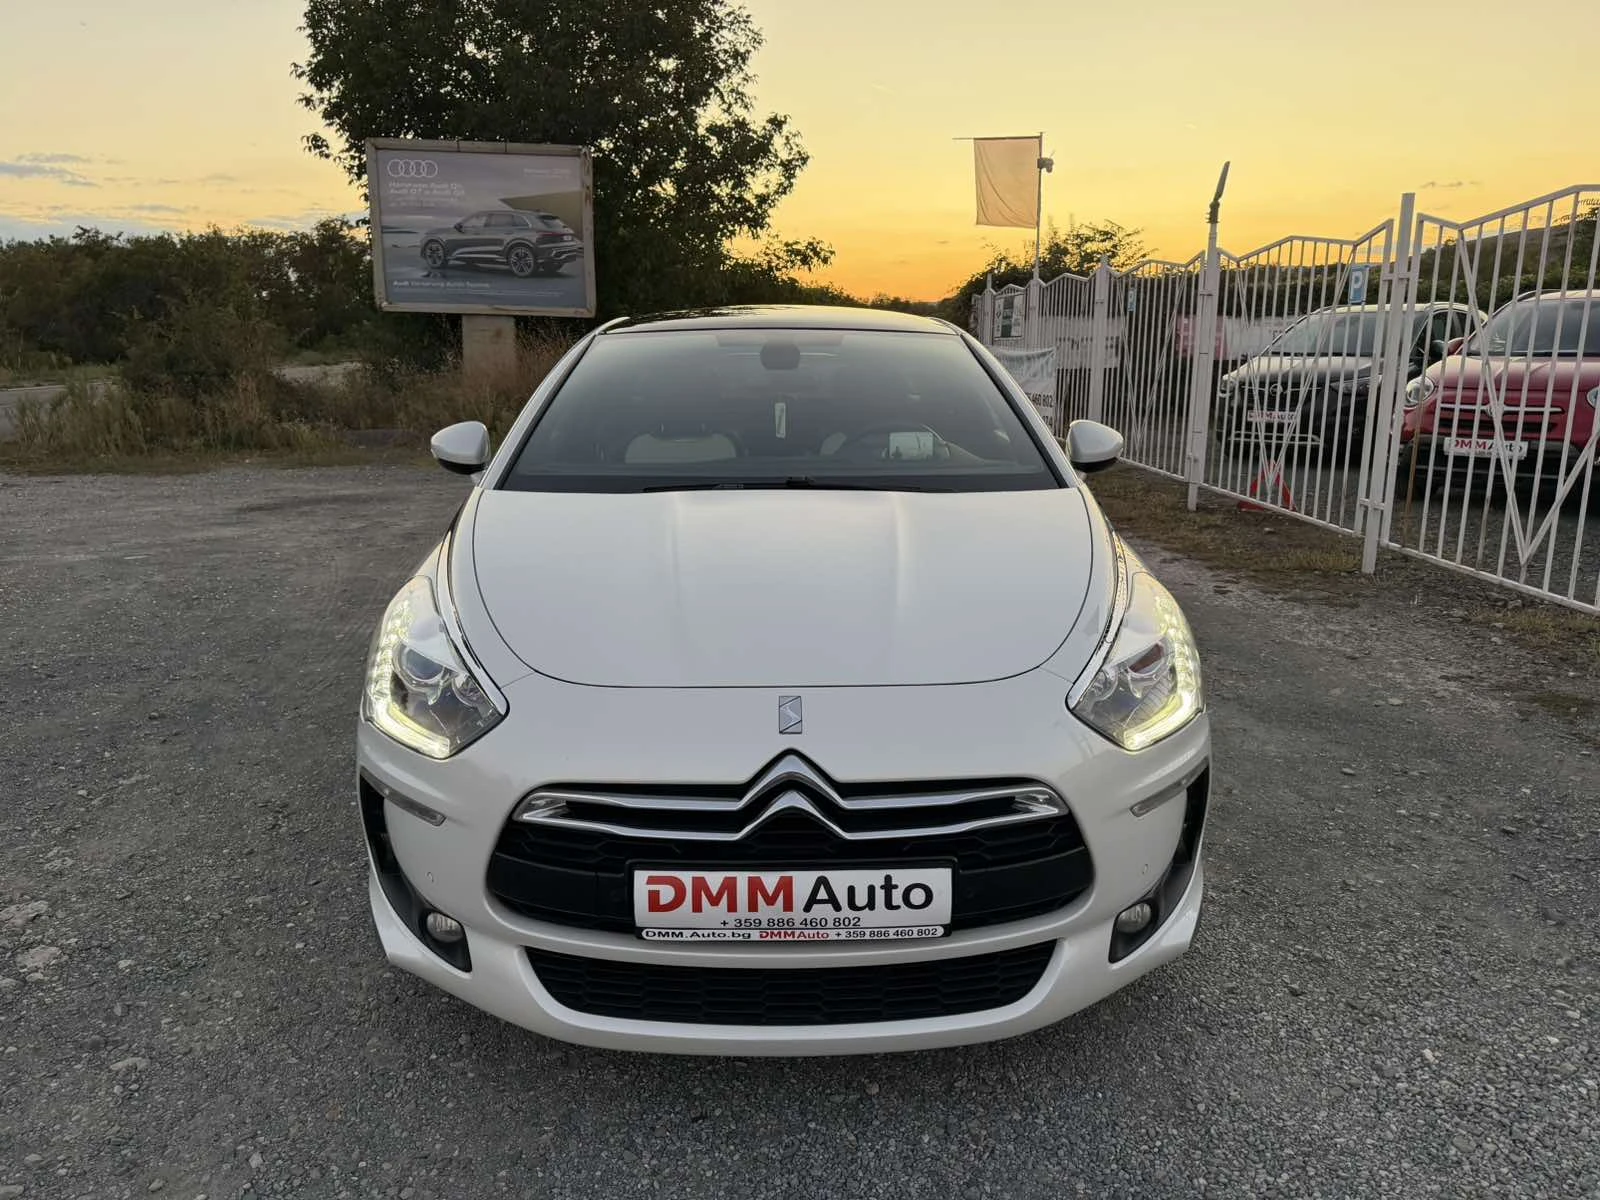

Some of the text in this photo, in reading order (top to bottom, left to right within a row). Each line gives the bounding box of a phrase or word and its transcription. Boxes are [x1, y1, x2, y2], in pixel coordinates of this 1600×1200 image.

[734, 918, 762, 928] 359
[767, 917, 795, 928] 886
[800, 917, 828, 928] 460
[832, 916, 861, 927] 802
[645, 930, 752, 940] DMM.Auto.bg
[845, 930, 866, 938] 359
[869, 929, 890, 938] 886
[893, 929, 914, 937] 460
[917, 928, 938, 937] 802
